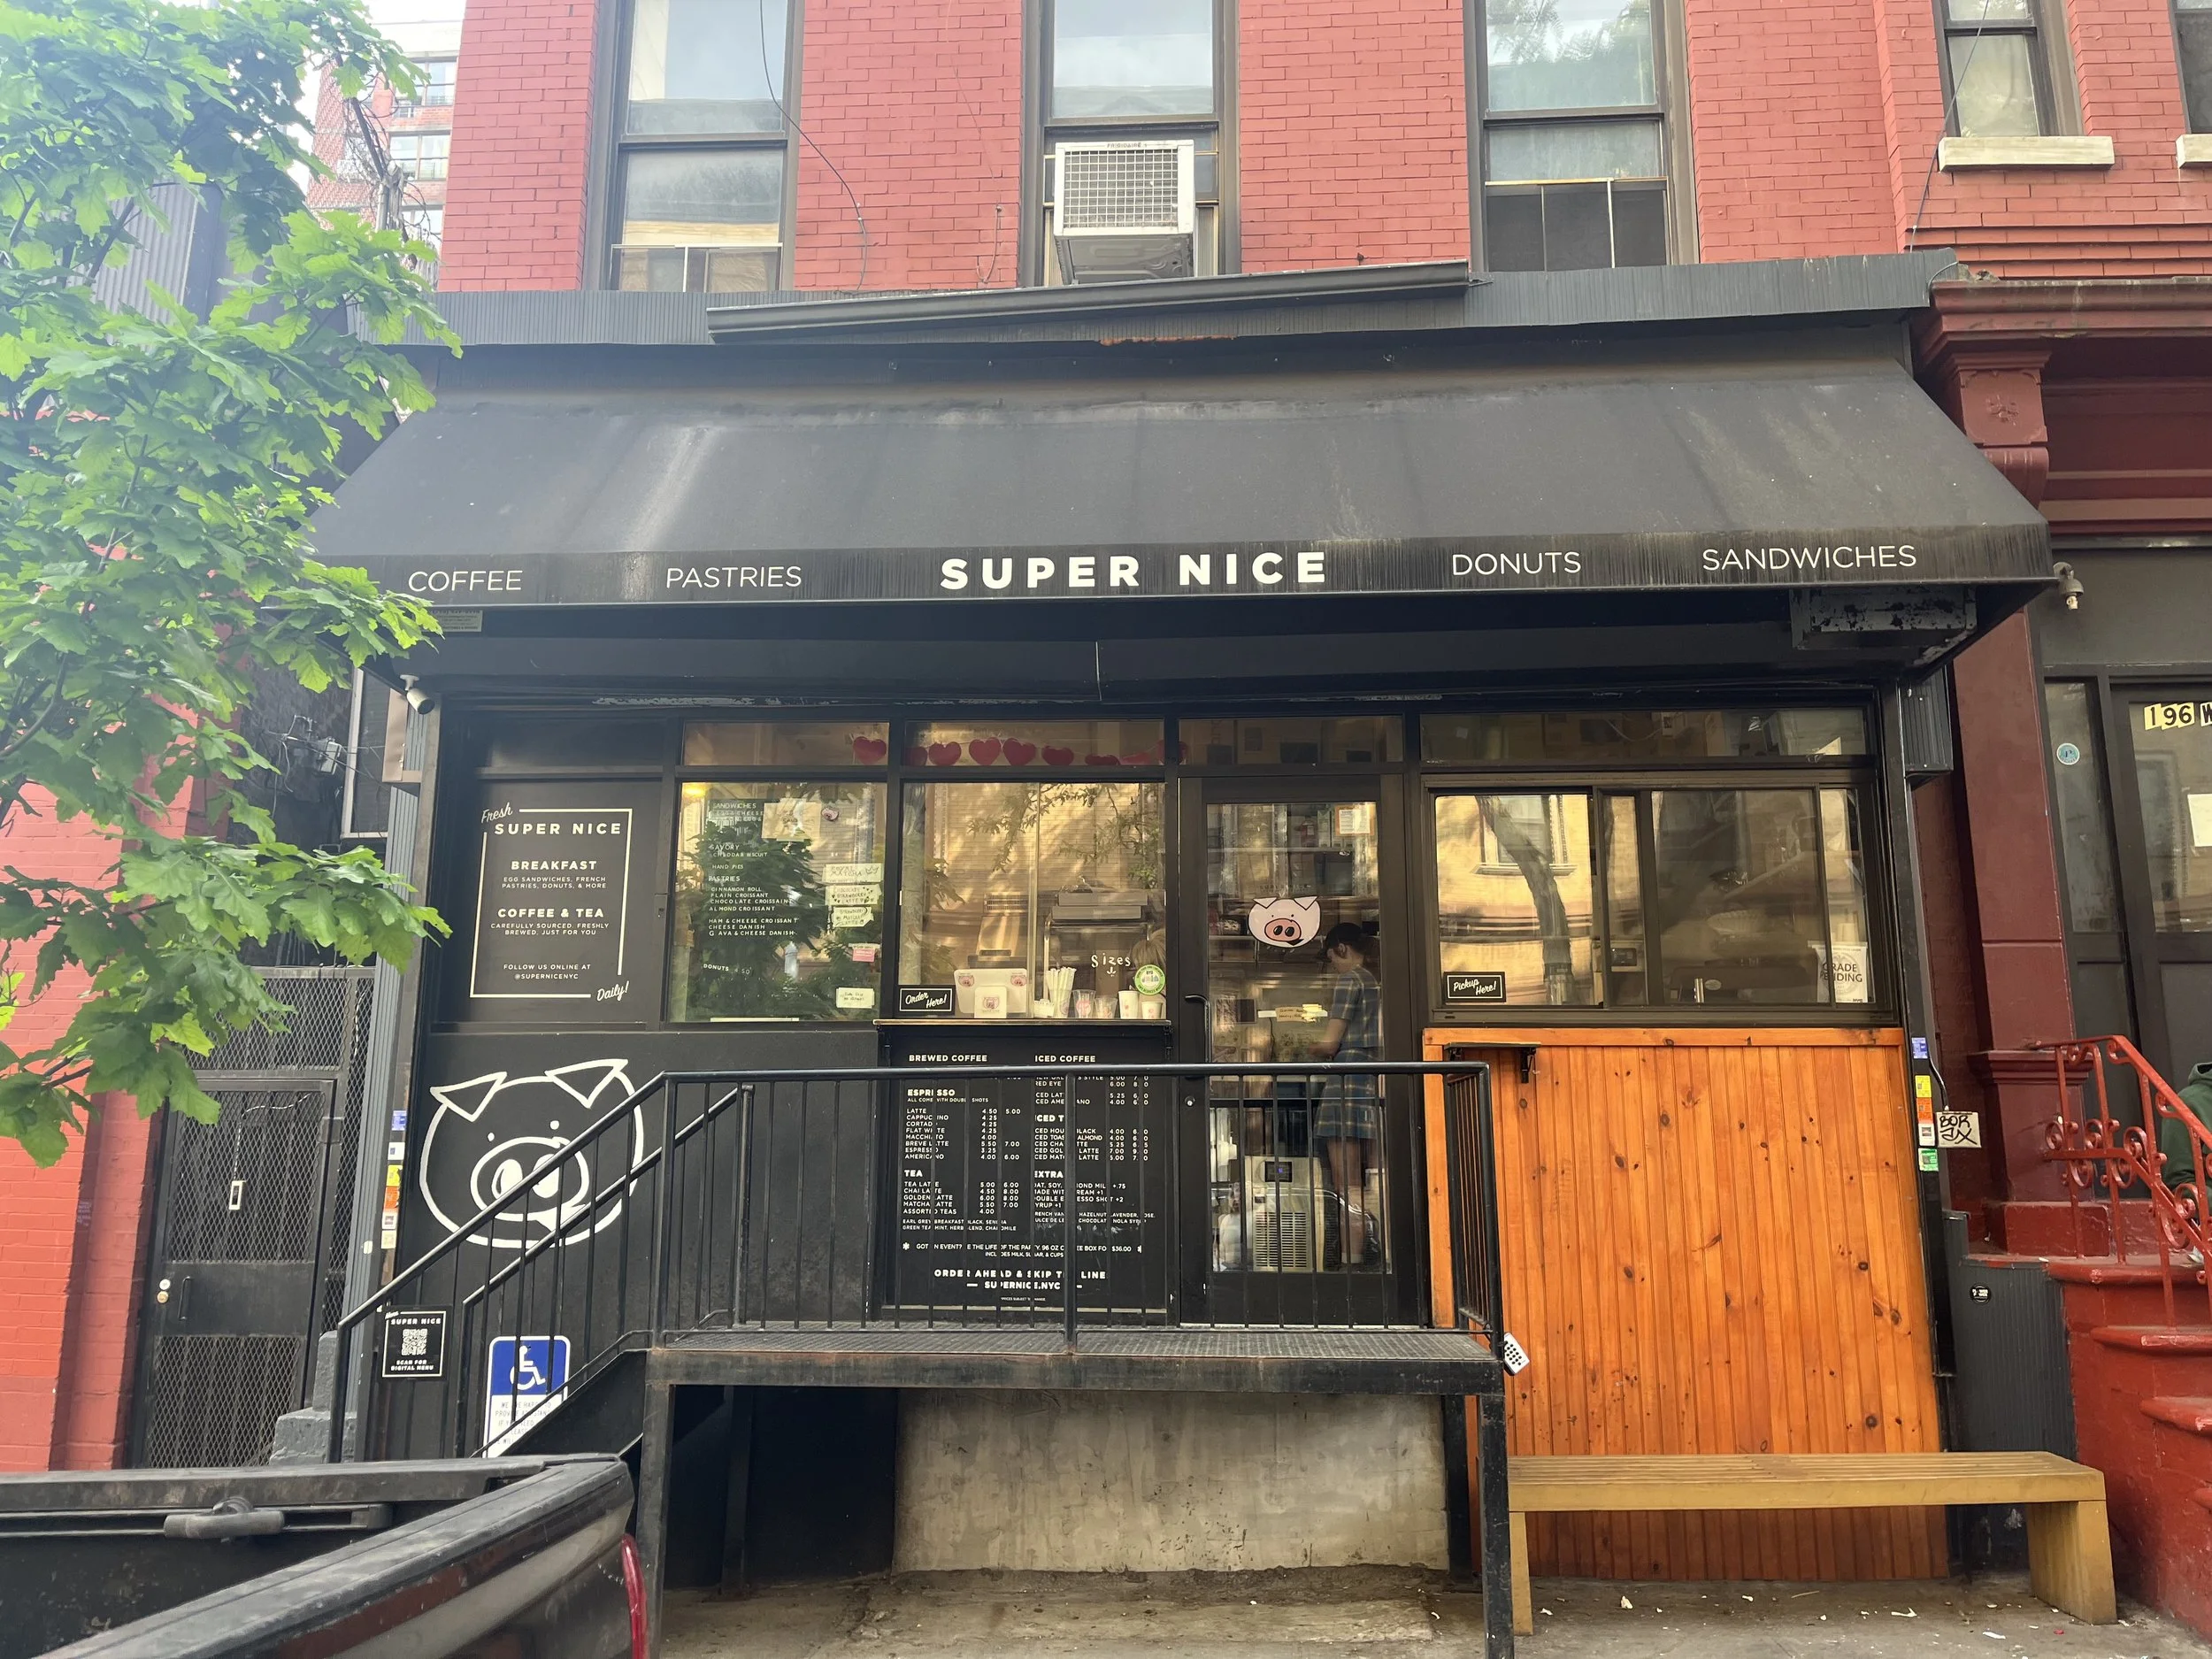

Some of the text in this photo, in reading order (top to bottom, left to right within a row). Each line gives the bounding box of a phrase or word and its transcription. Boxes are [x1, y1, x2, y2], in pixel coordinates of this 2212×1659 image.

[408, 545, 1916, 592] COFFEE PASTRIES SUPER NICE DONUTS SANDWICHES
[2151, 705, 2193, 726] 196
[481, 802, 513, 823] Fresh
[494, 823, 621, 835] SUPER NICE
[511, 860, 597, 871] BREAKFAST
[497, 908, 603, 918] COFFEE & TEA
[1091, 955, 1131, 967] Sizes
[596, 980, 629, 1001] Daily!
[1453, 979, 1479, 992] Pickup
[1475, 980, 1496, 995] Here!
[905, 992, 929, 1005] Order
[926, 996, 947, 1009] Here!
[1081, 1271, 1106, 1279] LINE
